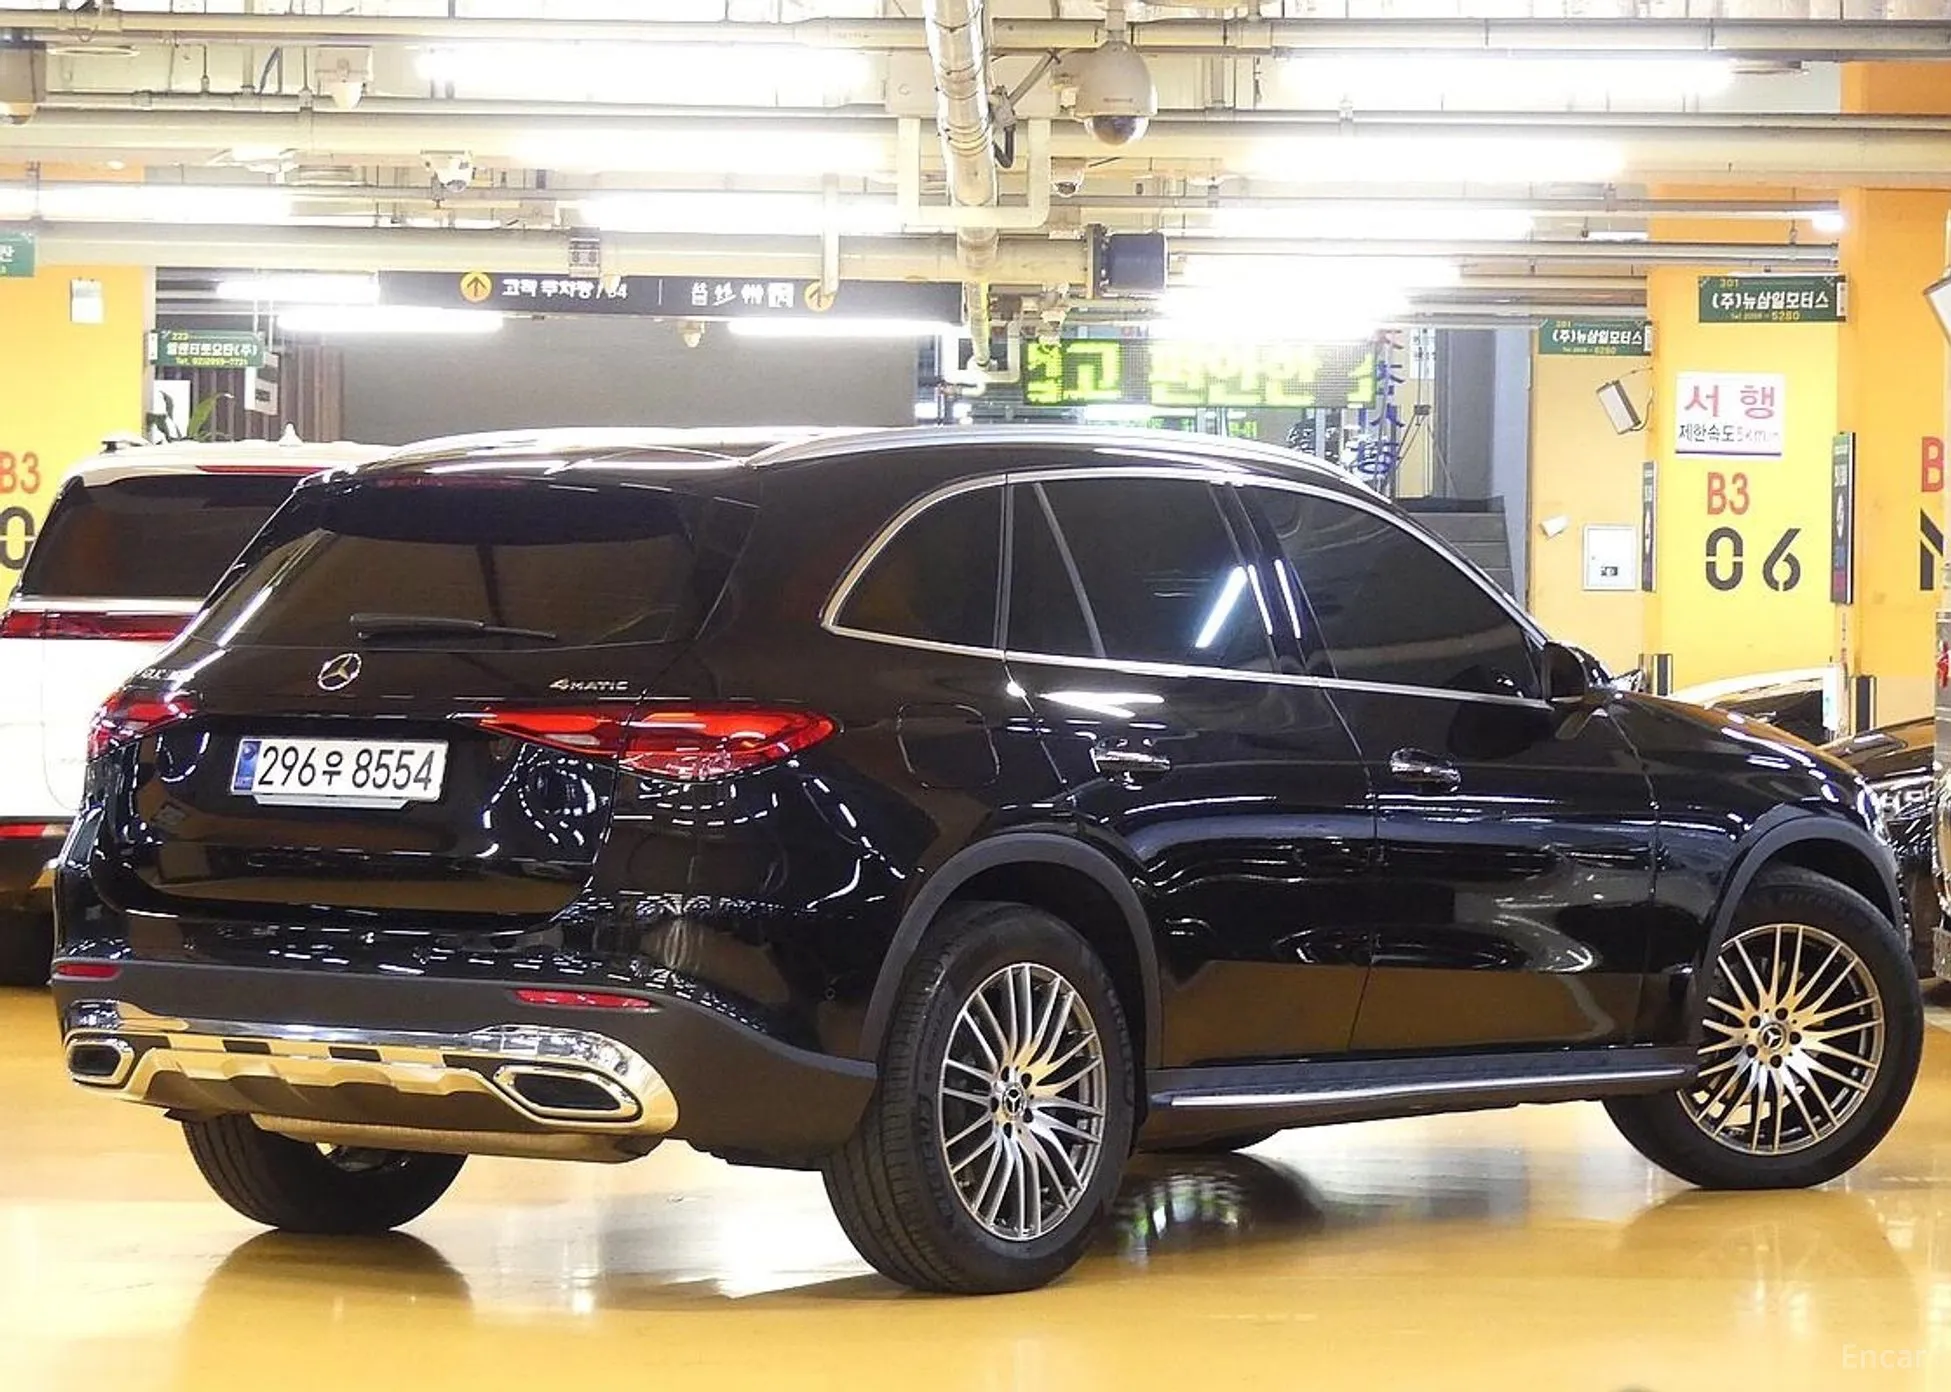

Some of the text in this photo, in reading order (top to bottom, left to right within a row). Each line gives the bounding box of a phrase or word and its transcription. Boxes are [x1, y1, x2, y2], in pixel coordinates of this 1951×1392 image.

[1711, 291, 1829, 310] (주)뉴삼일모터스
[1684, 385, 1775, 419] 서 행
[0, 451, 41, 494] B3
[1707, 472, 1750, 515] B3
[549, 678, 629, 691] 4MATIC
[258, 746, 435, 791] 296우 8554
